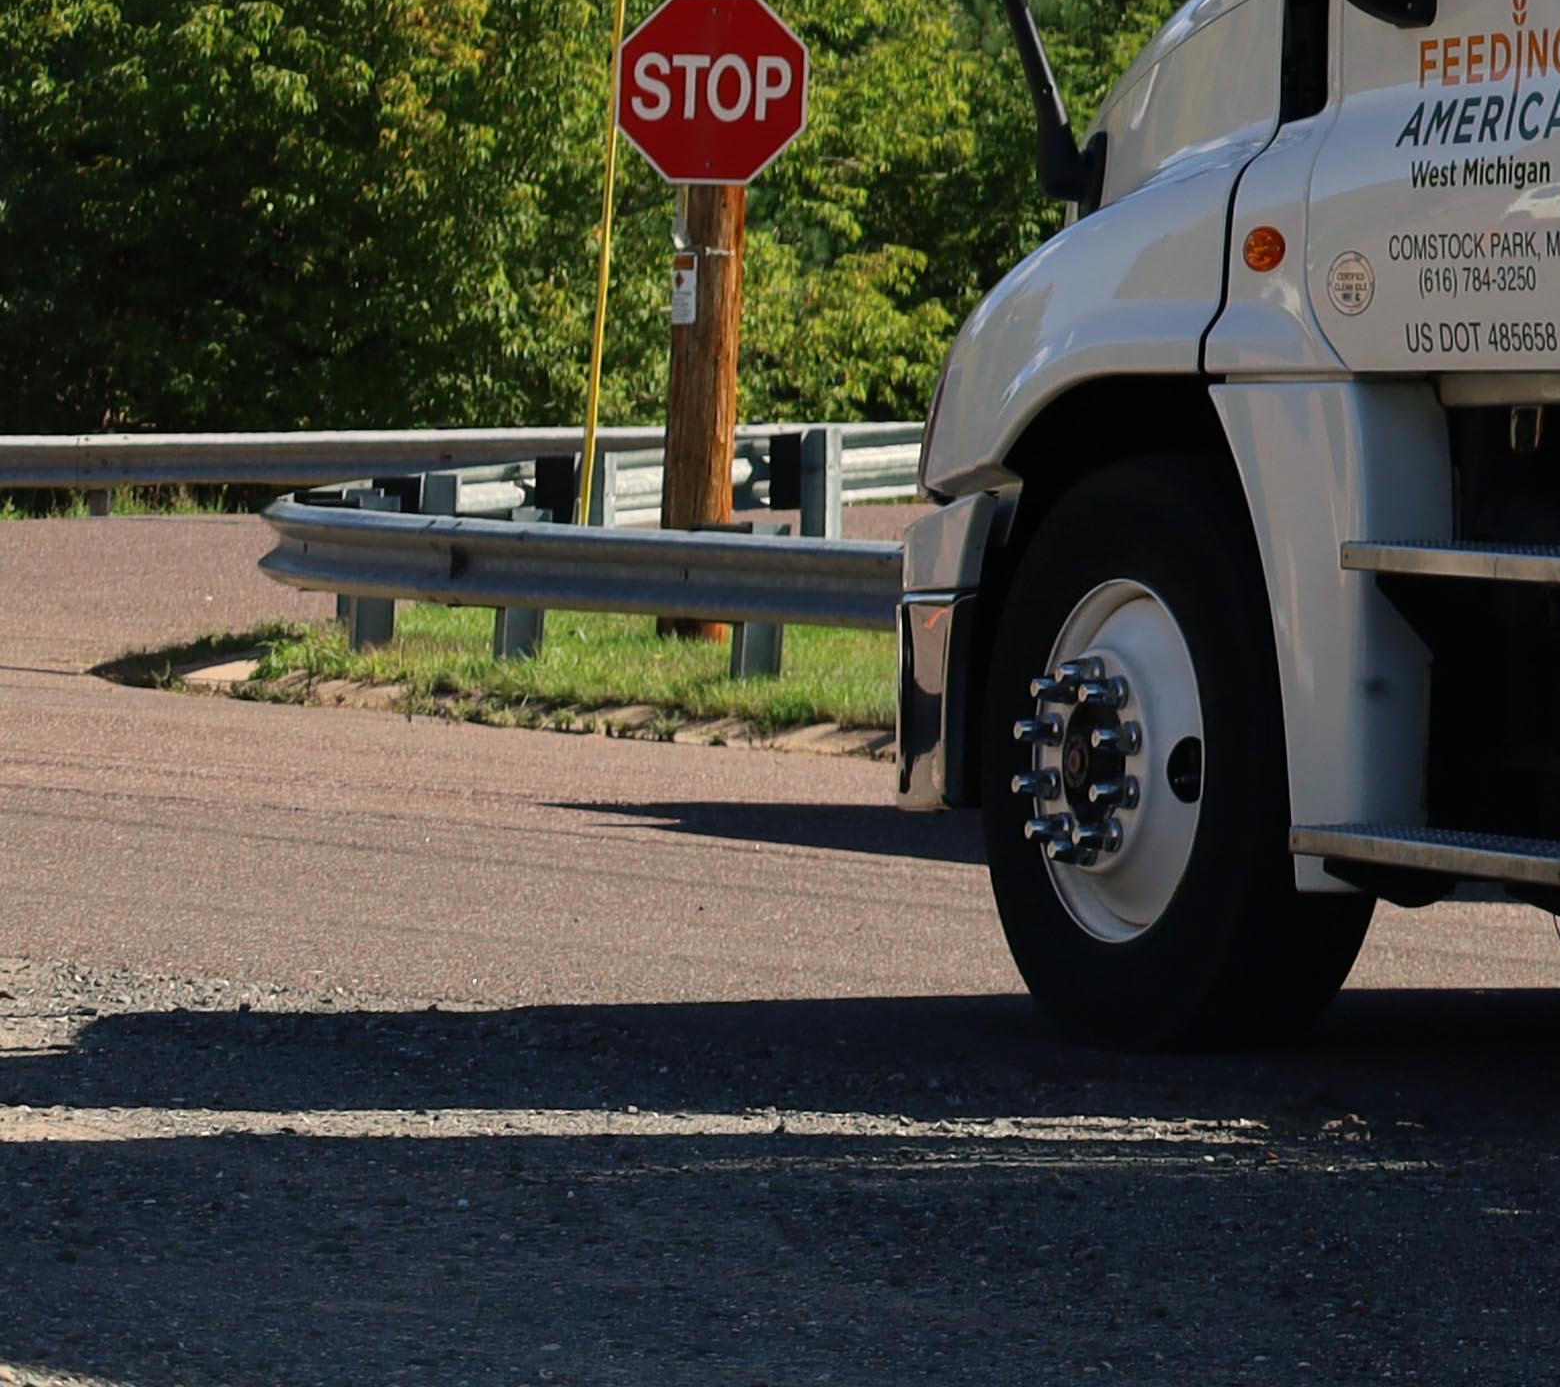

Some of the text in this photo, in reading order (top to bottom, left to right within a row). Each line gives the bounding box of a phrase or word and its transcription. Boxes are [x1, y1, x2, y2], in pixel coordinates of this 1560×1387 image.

[631, 51, 792, 122] STOP
[1411, 155, 1550, 190] West Michigan
[1388, 232, 1485, 261] COMSTOCK
[1490, 231, 1541, 262] PARK,
[1418, 265, 1536, 299] (616) 784-3250
[1405, 322, 1558, 353] US DOT 485658
